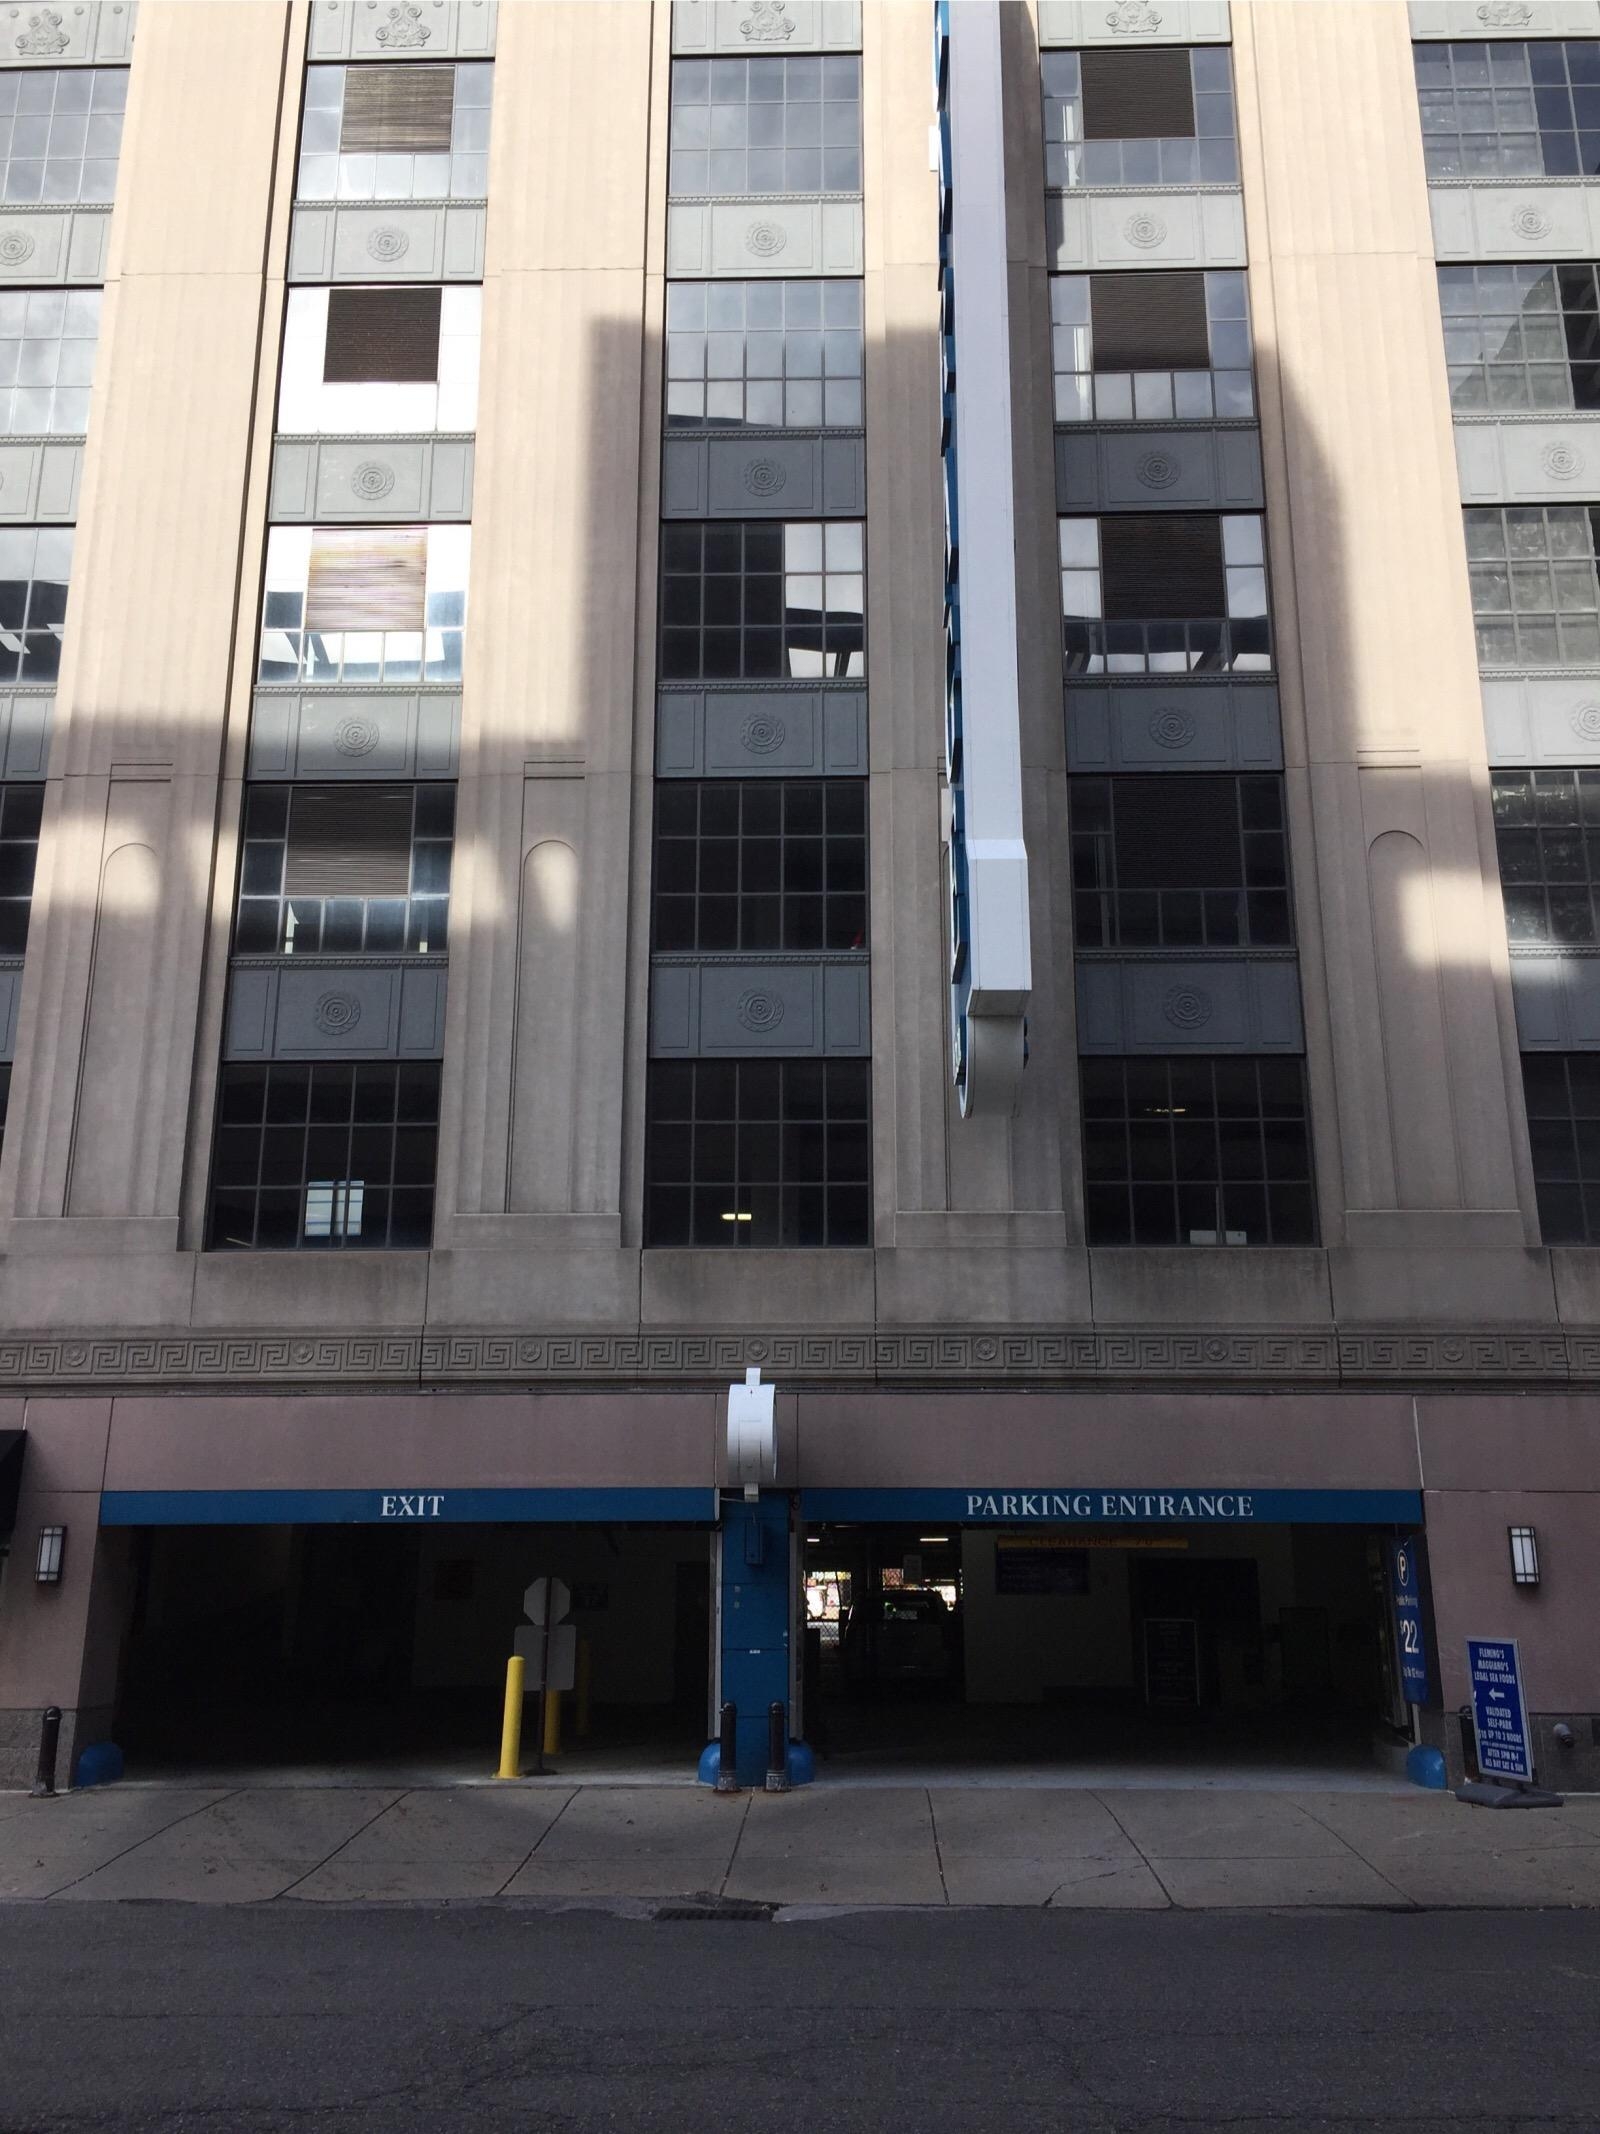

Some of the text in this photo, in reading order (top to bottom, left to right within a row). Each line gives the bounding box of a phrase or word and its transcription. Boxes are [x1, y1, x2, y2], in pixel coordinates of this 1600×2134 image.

[381, 1495, 445, 1517] EXIT
[967, 1494, 1255, 1518] PARKING ENTRANCE
[1478, 1647, 1505, 1659] FLEMING'S
[1477, 1659, 1509, 1672] MAGGIANO'S
[1474, 1670, 1516, 1685] LEGAL SEA FOODS
[1485, 1706, 1512, 1718] VALIDATED
[1487, 1717, 1513, 1730] SELF-PARK
[1487, 1729, 1494, 1739] UP
[1494, 1730, 1502, 1740] TO
[1506, 1732, 1522, 1743] HOURS
